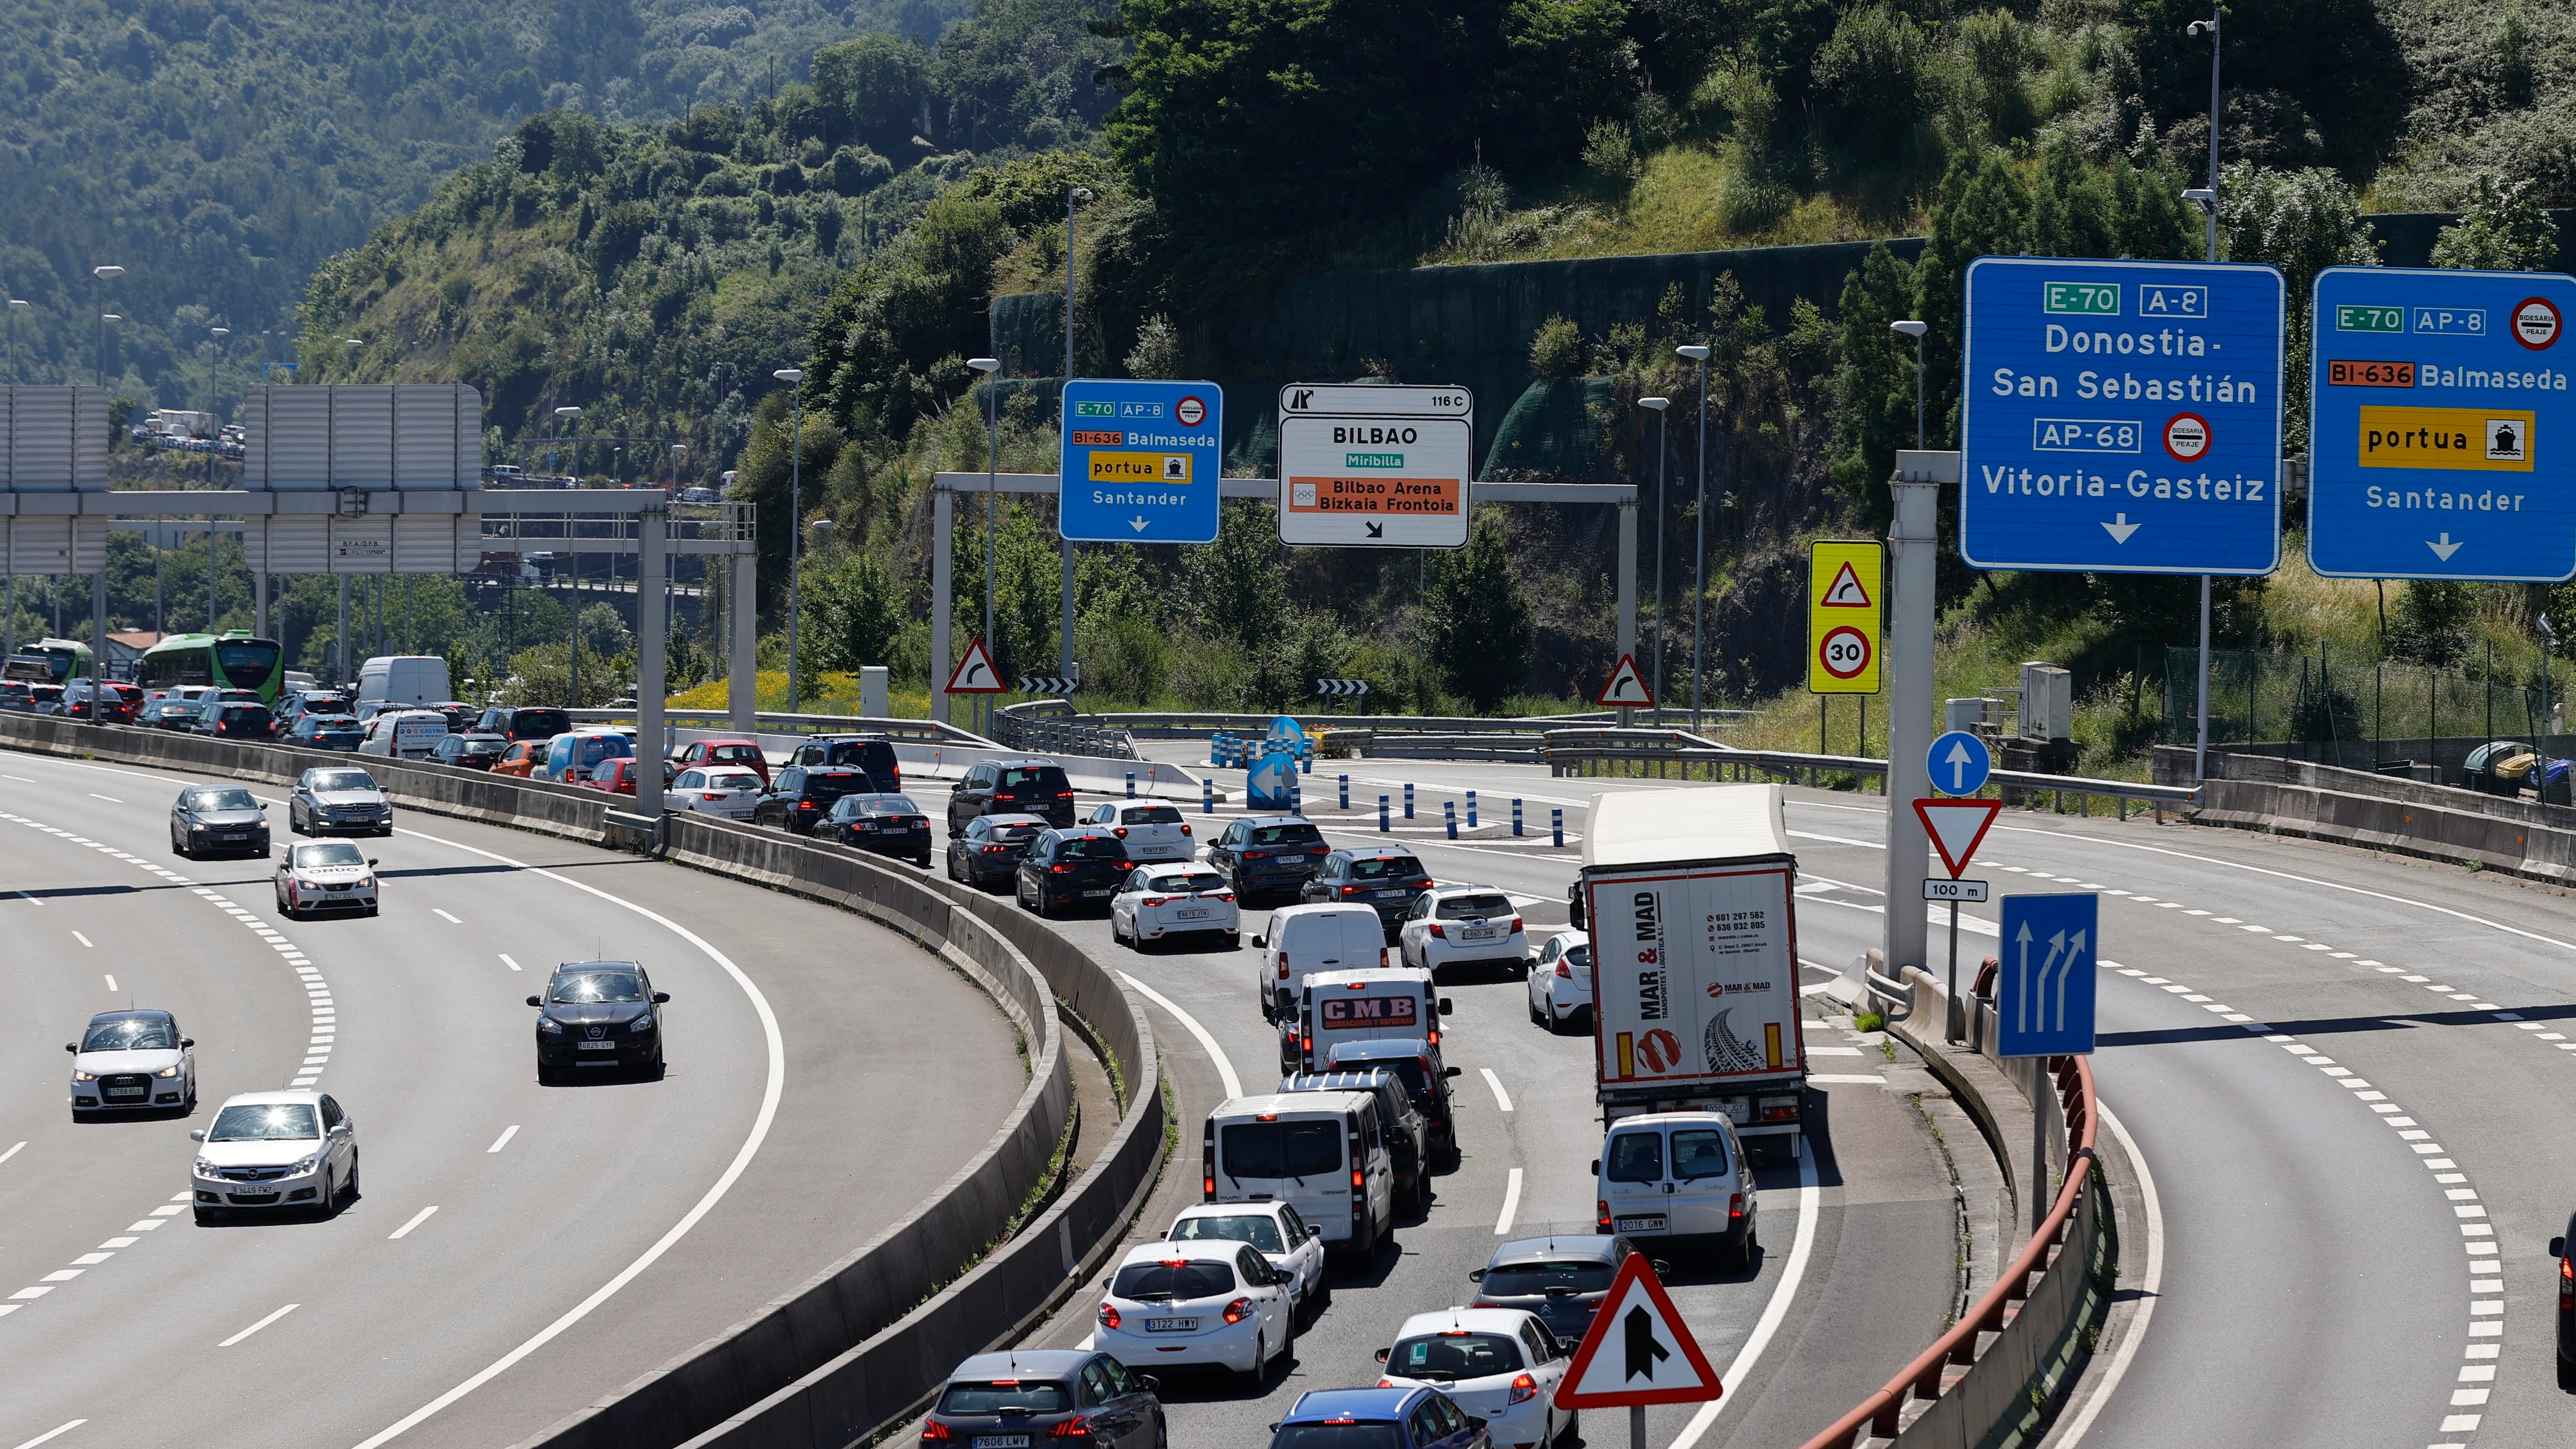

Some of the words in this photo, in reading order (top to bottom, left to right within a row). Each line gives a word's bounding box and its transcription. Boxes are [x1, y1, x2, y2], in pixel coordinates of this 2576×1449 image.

[2051, 288, 2114, 310] E-70
[2148, 290, 2197, 312] A-8
[2341, 310, 2399, 328] E-70
[2418, 312, 2481, 331] AP-8
[2046, 324, 2221, 356] Donostia-
[2332, 365, 2411, 383] BI-636
[2421, 365, 2567, 391] Balmaseda
[1992, 368, 2058, 398] San
[2076, 371, 2255, 403] Sebastián
[1432, 396, 1451, 407] 116
[1454, 397, 1463, 406] C
[1078, 404, 1112, 415] E-70
[1123, 405, 1161, 415] AP-8
[1074, 433, 1120, 443] BI-636
[1128, 432, 1215, 447] Balmaseda
[1333, 427, 1417, 444] BILBAO
[2041, 425, 2134, 447] AP-68
[2368, 428, 2467, 453] portua
[1348, 455, 1401, 466] Miribilla
[1094, 462, 1152, 476] portua
[1333, 481, 1386, 494] Bilbao
[1394, 482, 1441, 495] Arena
[1982, 465, 2264, 501] Vitoria-Gasteiz
[1093, 491, 1187, 505] Santander
[1320, 497, 1377, 509] Bizkaia
[1387, 498, 1454, 511] Frontoia
[2366, 485, 2525, 511] Santander
[1830, 644, 1860, 661] 30
[1932, 884, 1958, 896] 100
[1967, 887, 1978, 896] m
[1634, 892, 1656, 941] MAD
[1733, 912, 1747, 920] 297
[1750, 911, 1764, 919] 562
[1733, 922, 1748, 930] 032
[1638, 947, 1658, 964] &
[1744, 983, 1751, 991] &
[1639, 971, 1661, 1020] MAR
[1660, 975, 1668, 1019] TRANSPORTES
[1379, 1018, 1414, 1026] REFORMAS
[1623, 1221, 1643, 1229] 2016
[1648, 1219, 1664, 1228] GWW
[1150, 1320, 1173, 1328] 3122
[1178, 1319, 1196, 1327] HWY
[1413, 1346, 1424, 1359] L
[978, 1437, 1003, 1447] 7606
[1007, 1436, 1025, 1446] LMV
